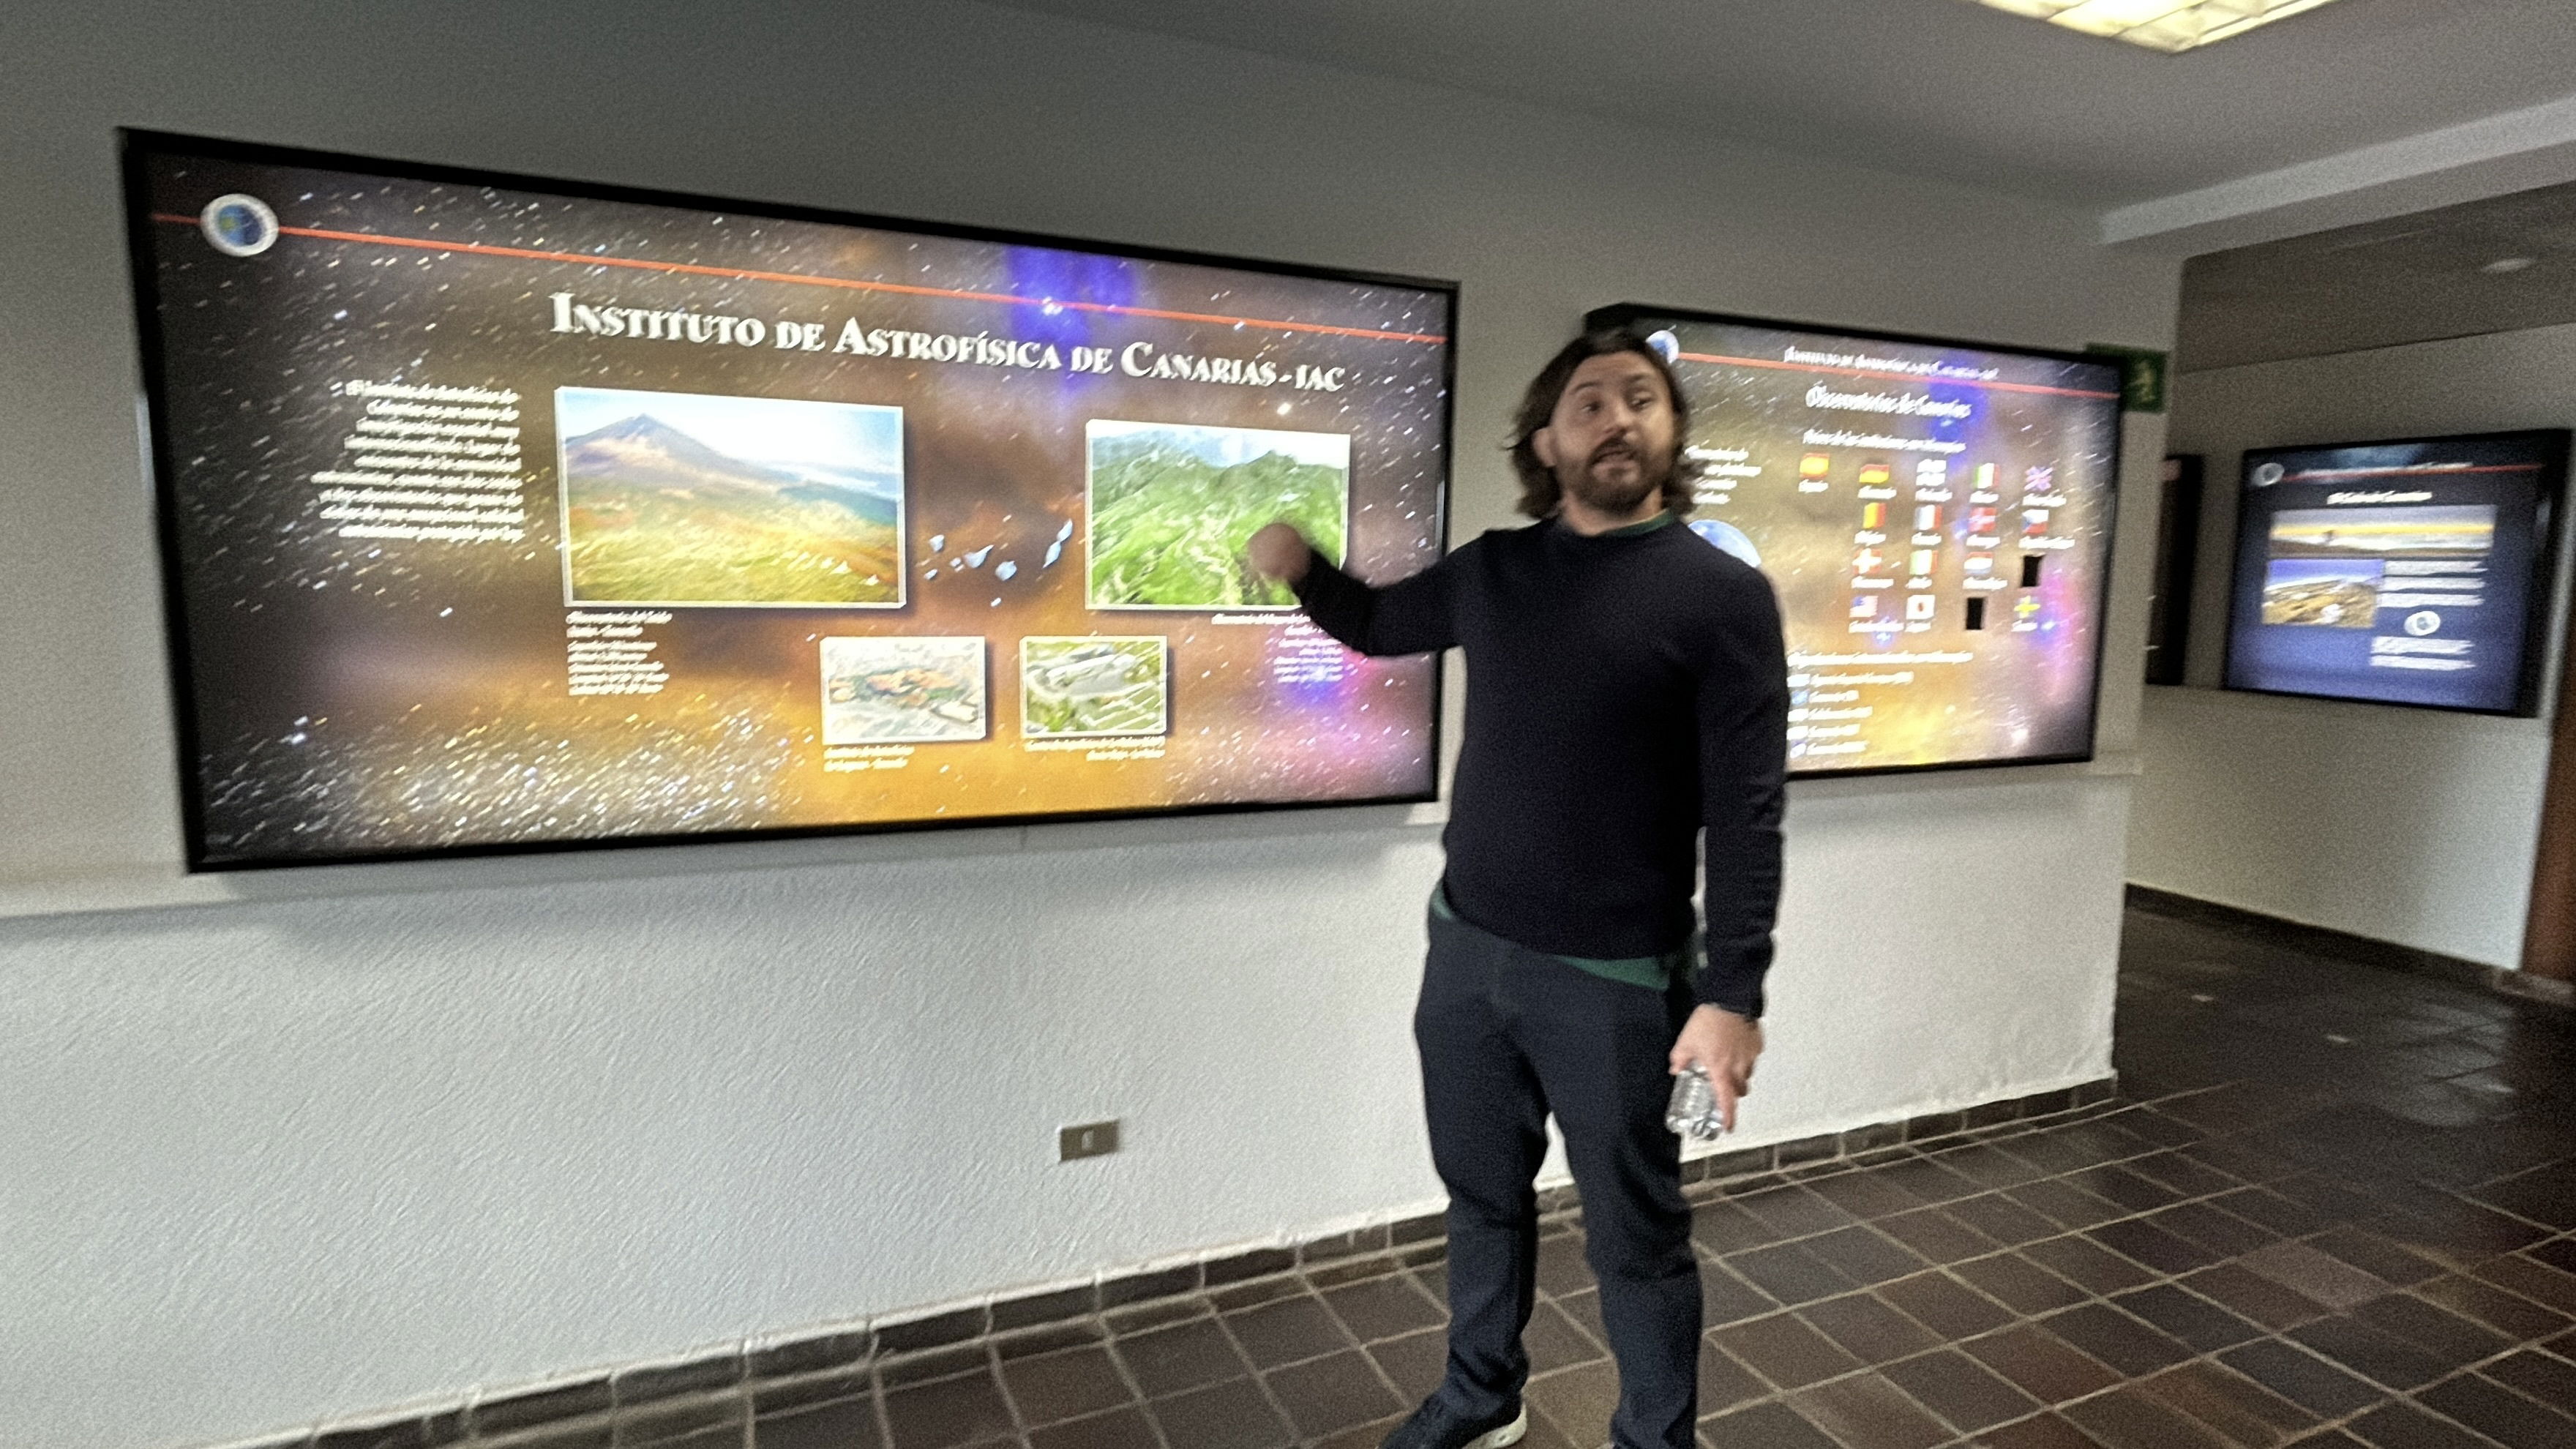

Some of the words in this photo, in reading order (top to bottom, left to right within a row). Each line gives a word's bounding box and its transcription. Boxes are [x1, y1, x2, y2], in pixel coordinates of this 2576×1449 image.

[550, 292, 765, 347] INSTITUTO
[774, 321, 825, 352] DE
[832, 317, 1061, 370] ASTROFÍSICA
[1070, 346, 1113, 374] DE
